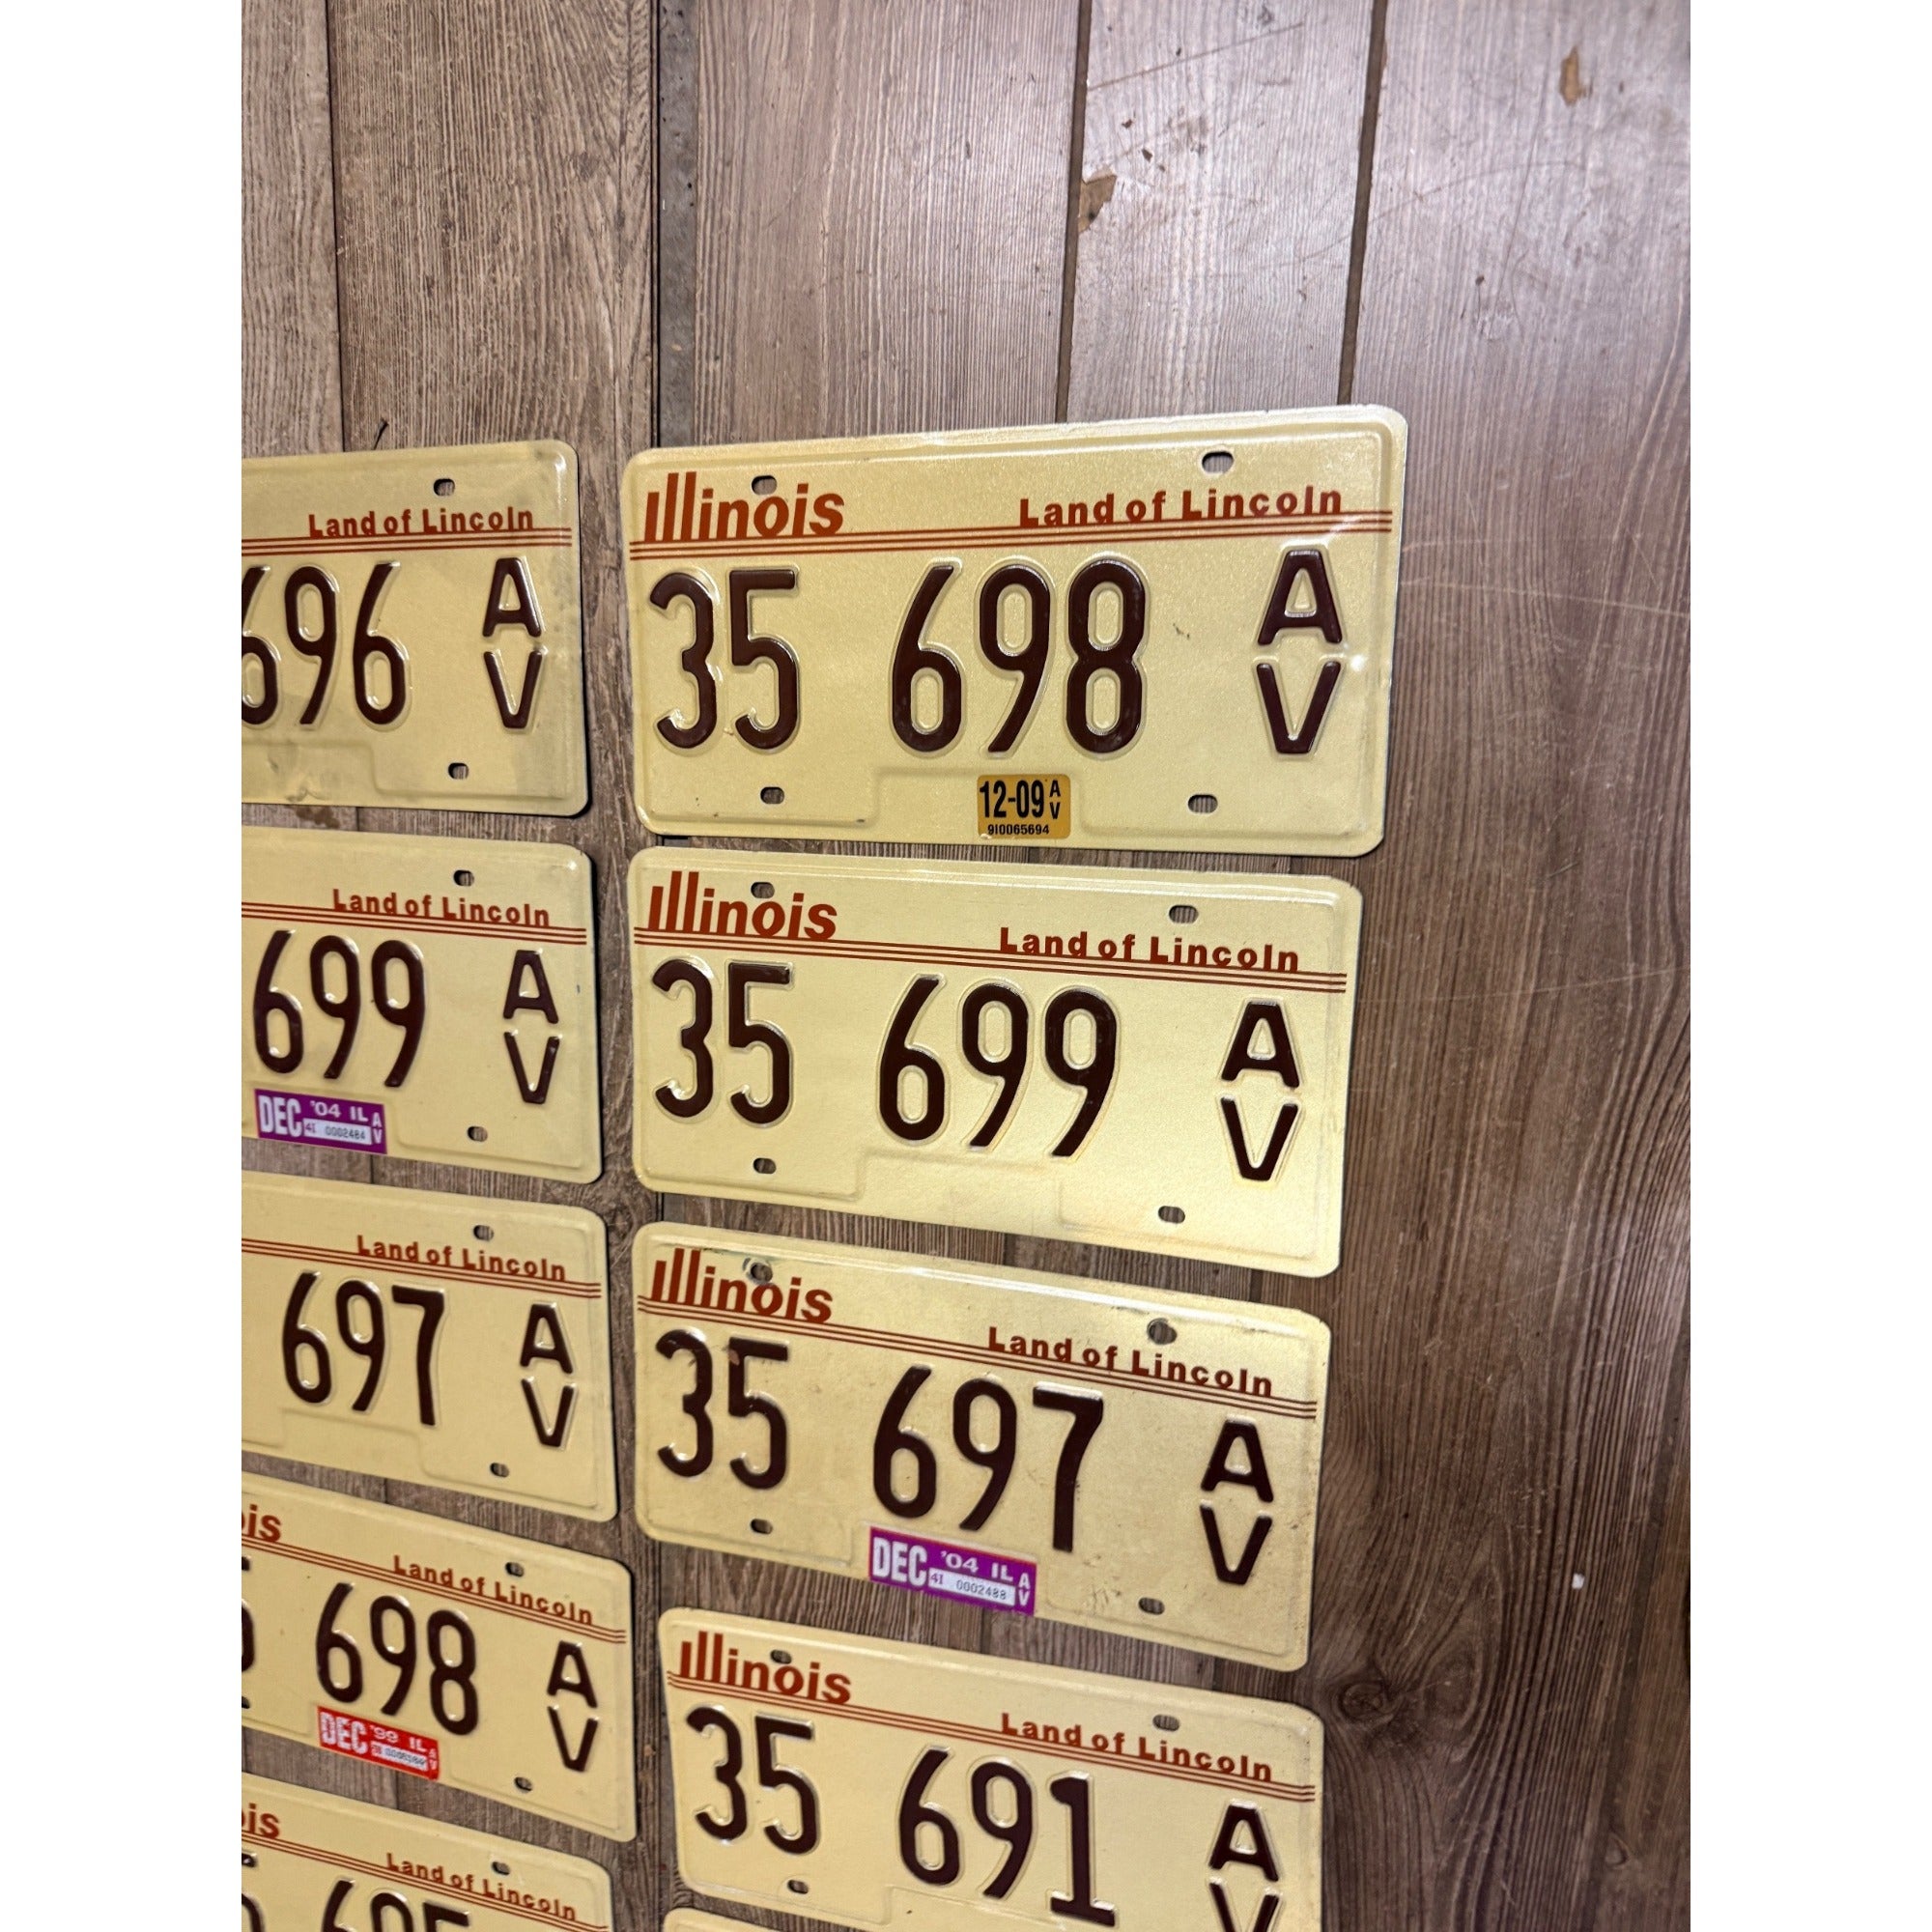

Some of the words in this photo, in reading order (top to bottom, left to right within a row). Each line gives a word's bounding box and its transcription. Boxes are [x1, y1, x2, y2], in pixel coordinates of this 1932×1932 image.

[309, 511, 375, 538] Land
[384, 509, 411, 534] of
[422, 507, 533, 532] Lincoln
[644, 471, 844, 542] Illinois
[1019, 494, 1114, 527] Land
[1126, 492, 1166, 522] of
[1182, 485, 1342, 519] Lincoln
[242, 562, 407, 725] 696
[650, 570, 799, 749] 35
[893, 559, 1147, 753] 698
[980, 780, 1044, 818] 12-09
[332, 889, 397, 915] Land
[405, 895, 431, 917] of
[442, 896, 550, 926] Lincoln
[647, 871, 838, 941] Illinois
[1000, 927, 1088, 957] Land
[1098, 934, 1135, 960] of
[1151, 937, 1298, 972] Lincoln
[253, 930, 426, 1087] 699
[652, 959, 791, 1124] 35
[879, 978, 1117, 1157] 699
[258, 1095, 302, 1137] DEC
[350, 1106, 368, 1122] IL
[357, 1236, 417, 1264] Land
[427, 1245, 451, 1266] of
[463, 1248, 566, 1281] Lincoln
[651, 1248, 833, 1323] Illinois
[282, 1271, 444, 1426] 697
[988, 1326, 1071, 1362] Land
[1083, 1346, 1117, 1370] of
[1132, 1350, 1272, 1397] Lincoln
[656, 1329, 788, 1490] 35
[873, 1365, 1103, 1552] 697
[393, 1555, 452, 1587] Land
[461, 1577, 484, 1593] of
[495, 1581, 592, 1626] Lincoln
[872, 1536, 927, 1587] DEC
[991, 1563, 1013, 1581] IL
[316, 1582, 479, 1736] 698
[680, 1631, 851, 1705] Illinois
[320, 1712, 367, 1754] DEC
[410, 1737, 427, 1752] IL
[1002, 1713, 1081, 1747] Land
[1093, 1732, 1124, 1755] of
[1139, 1737, 1271, 1782] Lincoln
[686, 1706, 818, 1855] 35
[899, 1748, 1116, 1927] 691
[387, 1853, 443, 1884] Land
[450, 1875, 474, 1890] of
[483, 1879, 577, 1922] Lincoln
